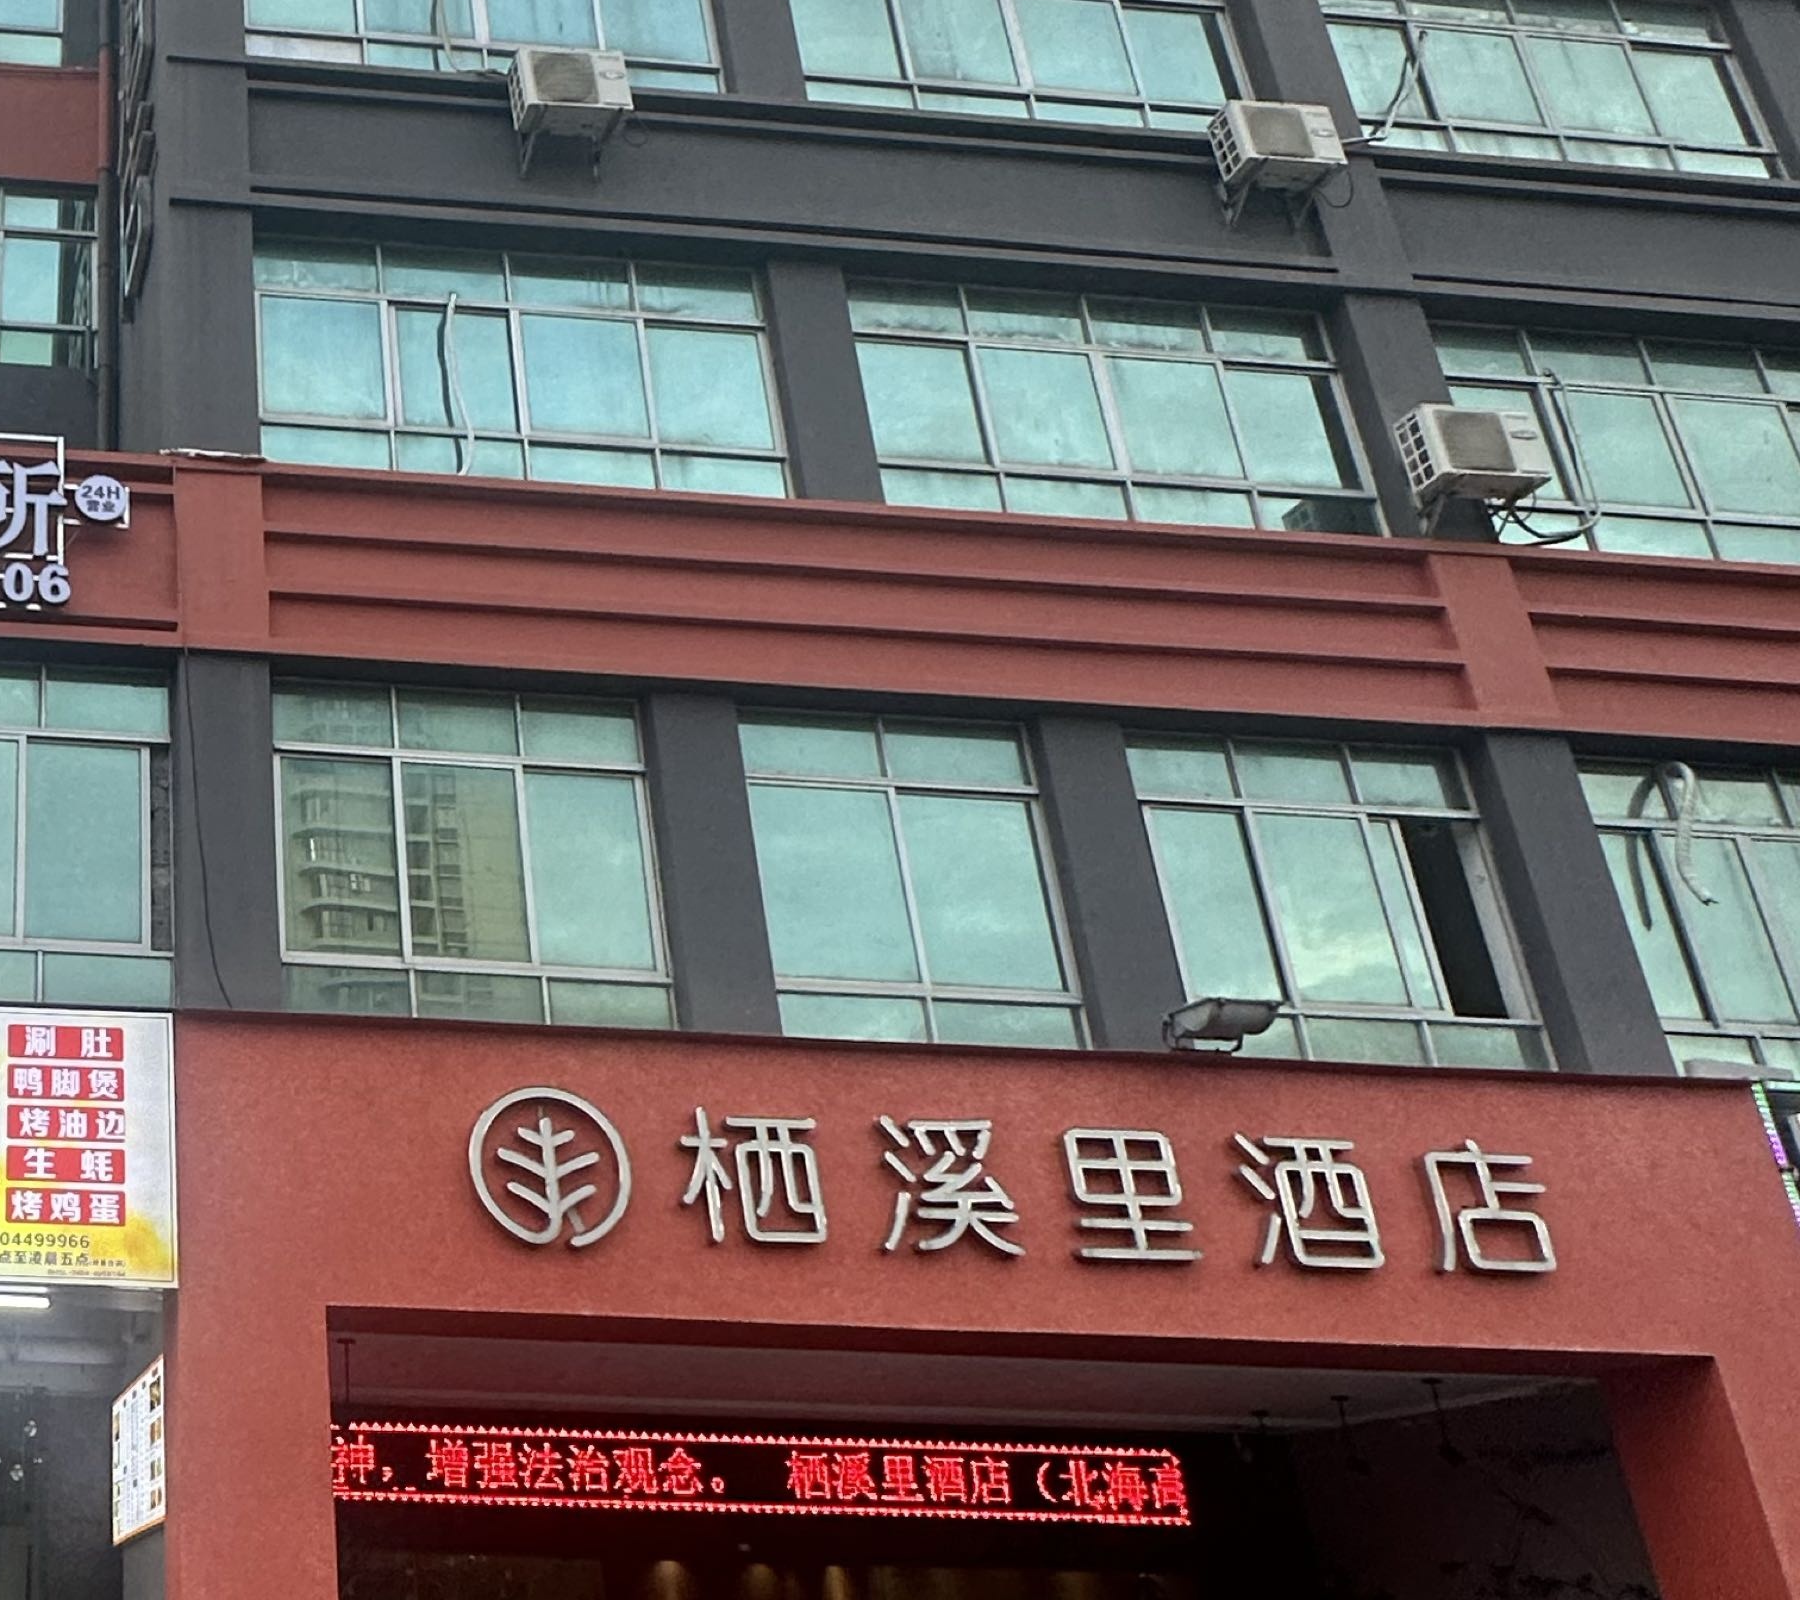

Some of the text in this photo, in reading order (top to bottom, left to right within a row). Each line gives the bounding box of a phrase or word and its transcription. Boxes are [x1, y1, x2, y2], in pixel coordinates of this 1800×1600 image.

[81, 485, 120, 500] 24H
[85, 500, 116, 513] 营业
[23, 1025, 113, 1058] 涮肚
[12, 1067, 119, 1099] 鸭脚煲
[18, 1107, 126, 1139] 烤油边
[23, 1148, 114, 1182] 生蚝
[680, 1105, 1559, 1274] 栖溪里酒店
[11, 1190, 121, 1224] 烤鸡蛋
